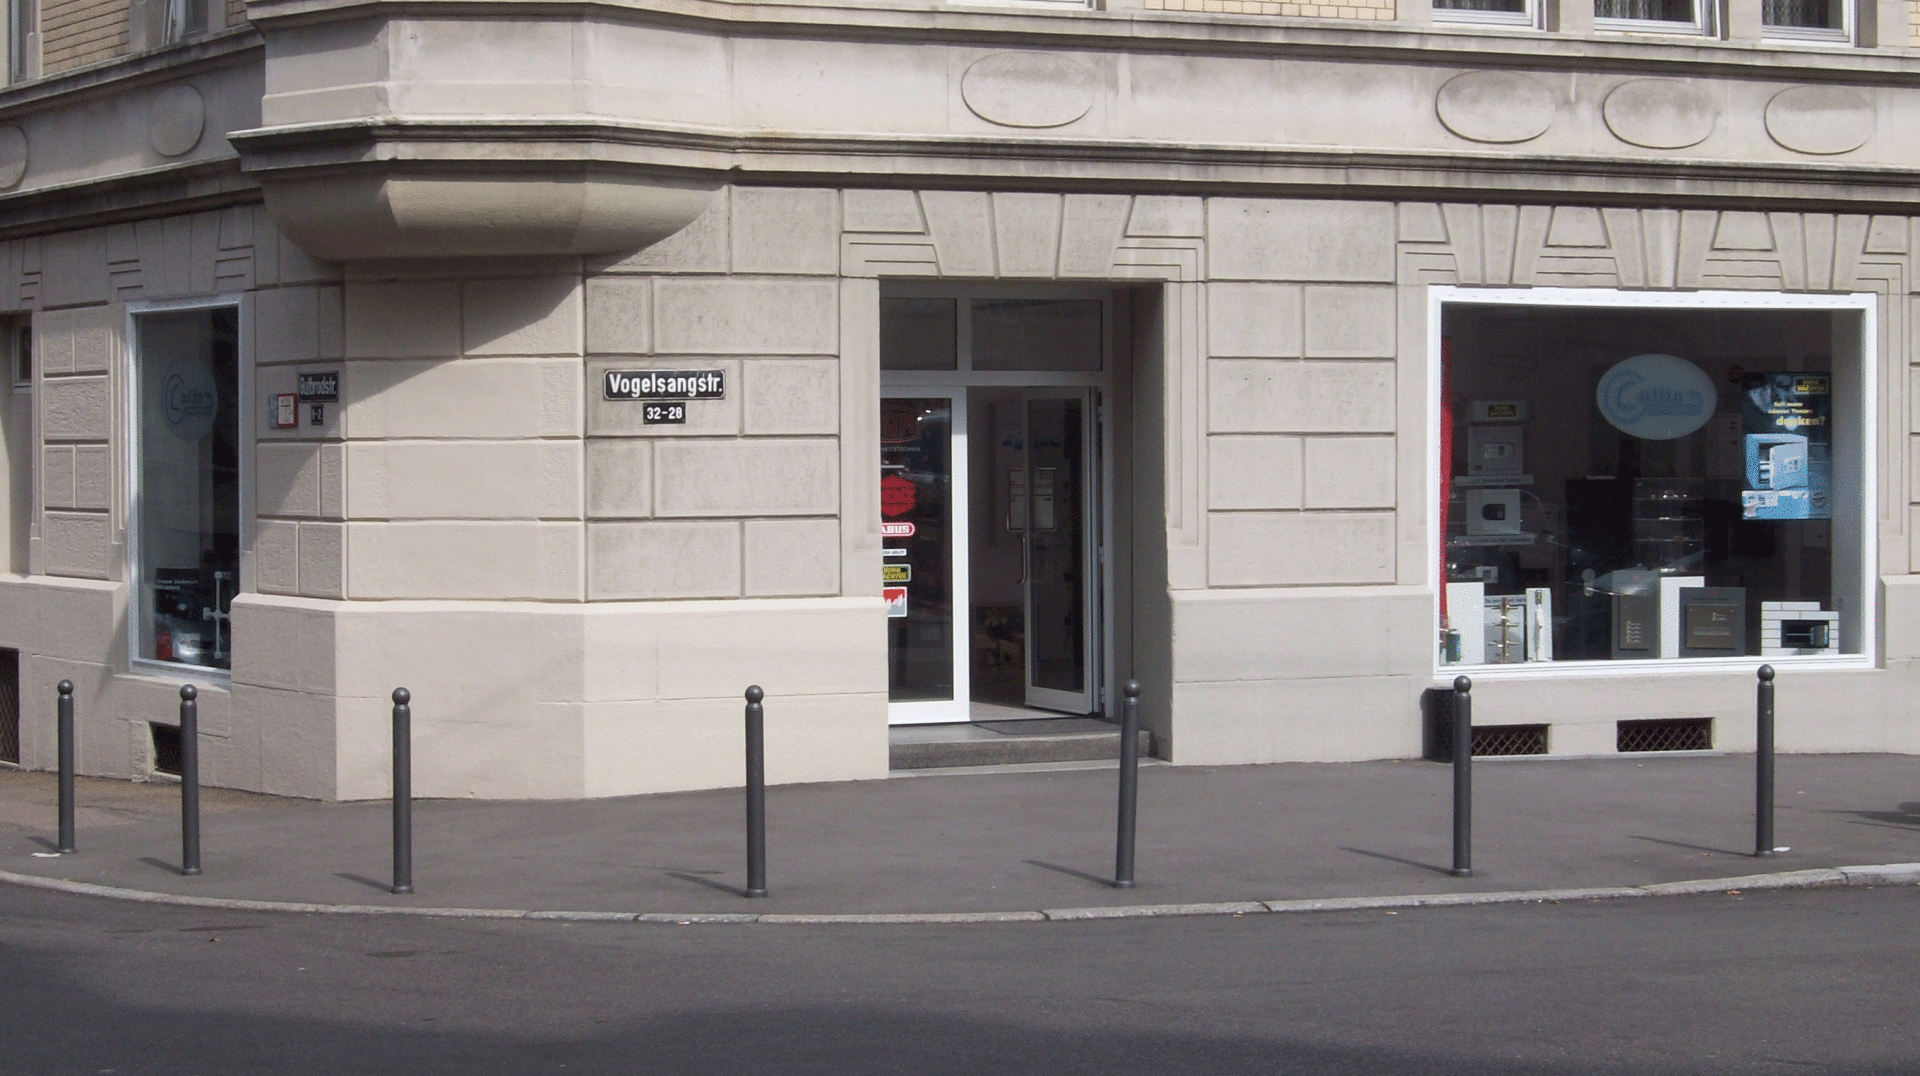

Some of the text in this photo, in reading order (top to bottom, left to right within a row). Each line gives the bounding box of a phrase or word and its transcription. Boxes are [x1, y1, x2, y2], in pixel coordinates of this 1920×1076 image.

[609, 373, 722, 398] Vogelsangstr.
[312, 408, 322, 421] 1-2
[646, 406, 682, 420] 32-28
[882, 525, 911, 534] ABUS
